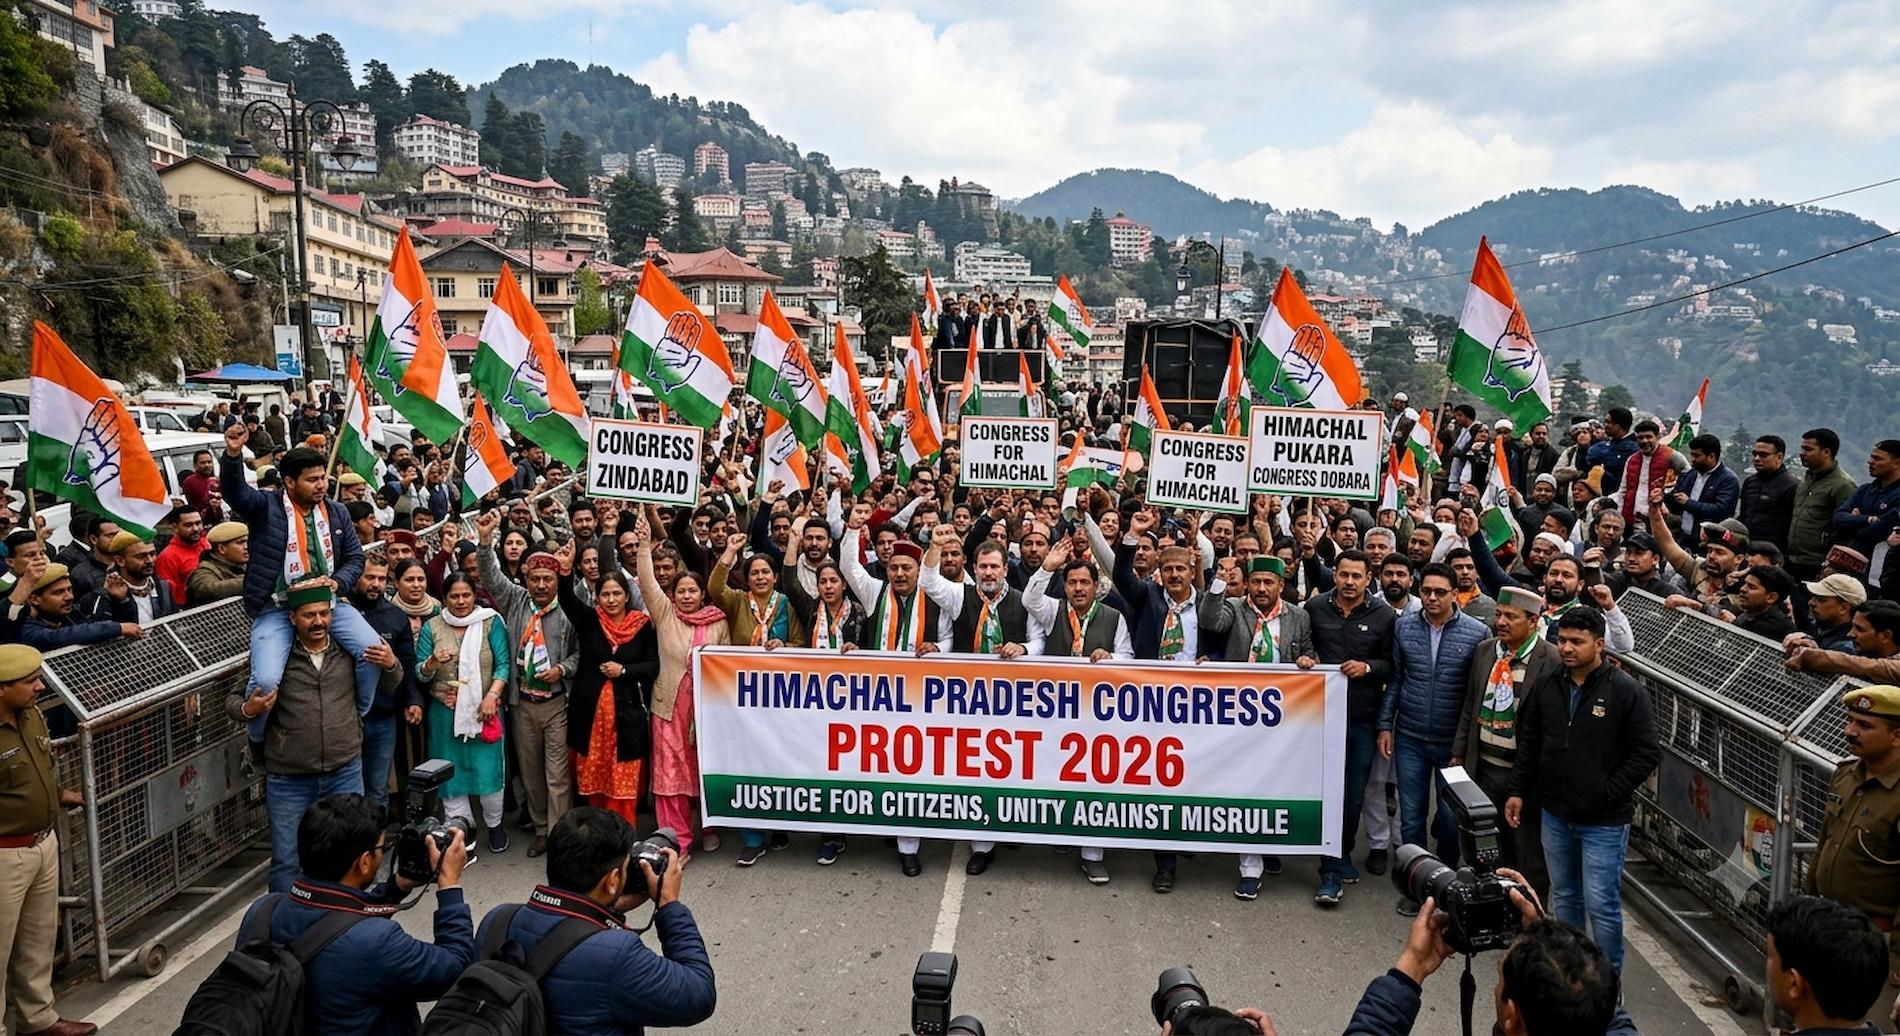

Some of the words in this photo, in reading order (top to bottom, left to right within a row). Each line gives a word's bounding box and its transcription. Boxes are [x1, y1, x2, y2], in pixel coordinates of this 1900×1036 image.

[970, 424, 1049, 442] CONGRESS
[1264, 415, 1367, 440] HIMACHAL
[597, 429, 694, 462] CONGRESS
[994, 445, 1023, 460] FOR
[1161, 438, 1246, 462] CONGRESS
[1273, 442, 1354, 466] PUKARA
[596, 463, 689, 495] ZINDABAD
[969, 463, 1048, 481] HIMACHAL
[1184, 462, 1216, 481] FOR
[1253, 467, 1317, 487] CONGRESS
[1321, 471, 1371, 490] DOBARA
[1156, 480, 1239, 505] HIMACHAL
[737, 671, 912, 713] HIMACHAL
[923, 677, 1079, 720] PRADESH
[1092, 683, 1283, 727] CONGRESS
[828, 723, 1042, 780] PROTEST
[1059, 732, 1184, 787] 2026
[730, 784, 822, 813] JUSTICE
[829, 788, 874, 816] FOR
[880, 791, 991, 826] CITIZENS,
[997, 797, 1067, 824] UNITY
[1072, 801, 1174, 831] AGAINST
[1181, 805, 1289, 835] MISRULE
